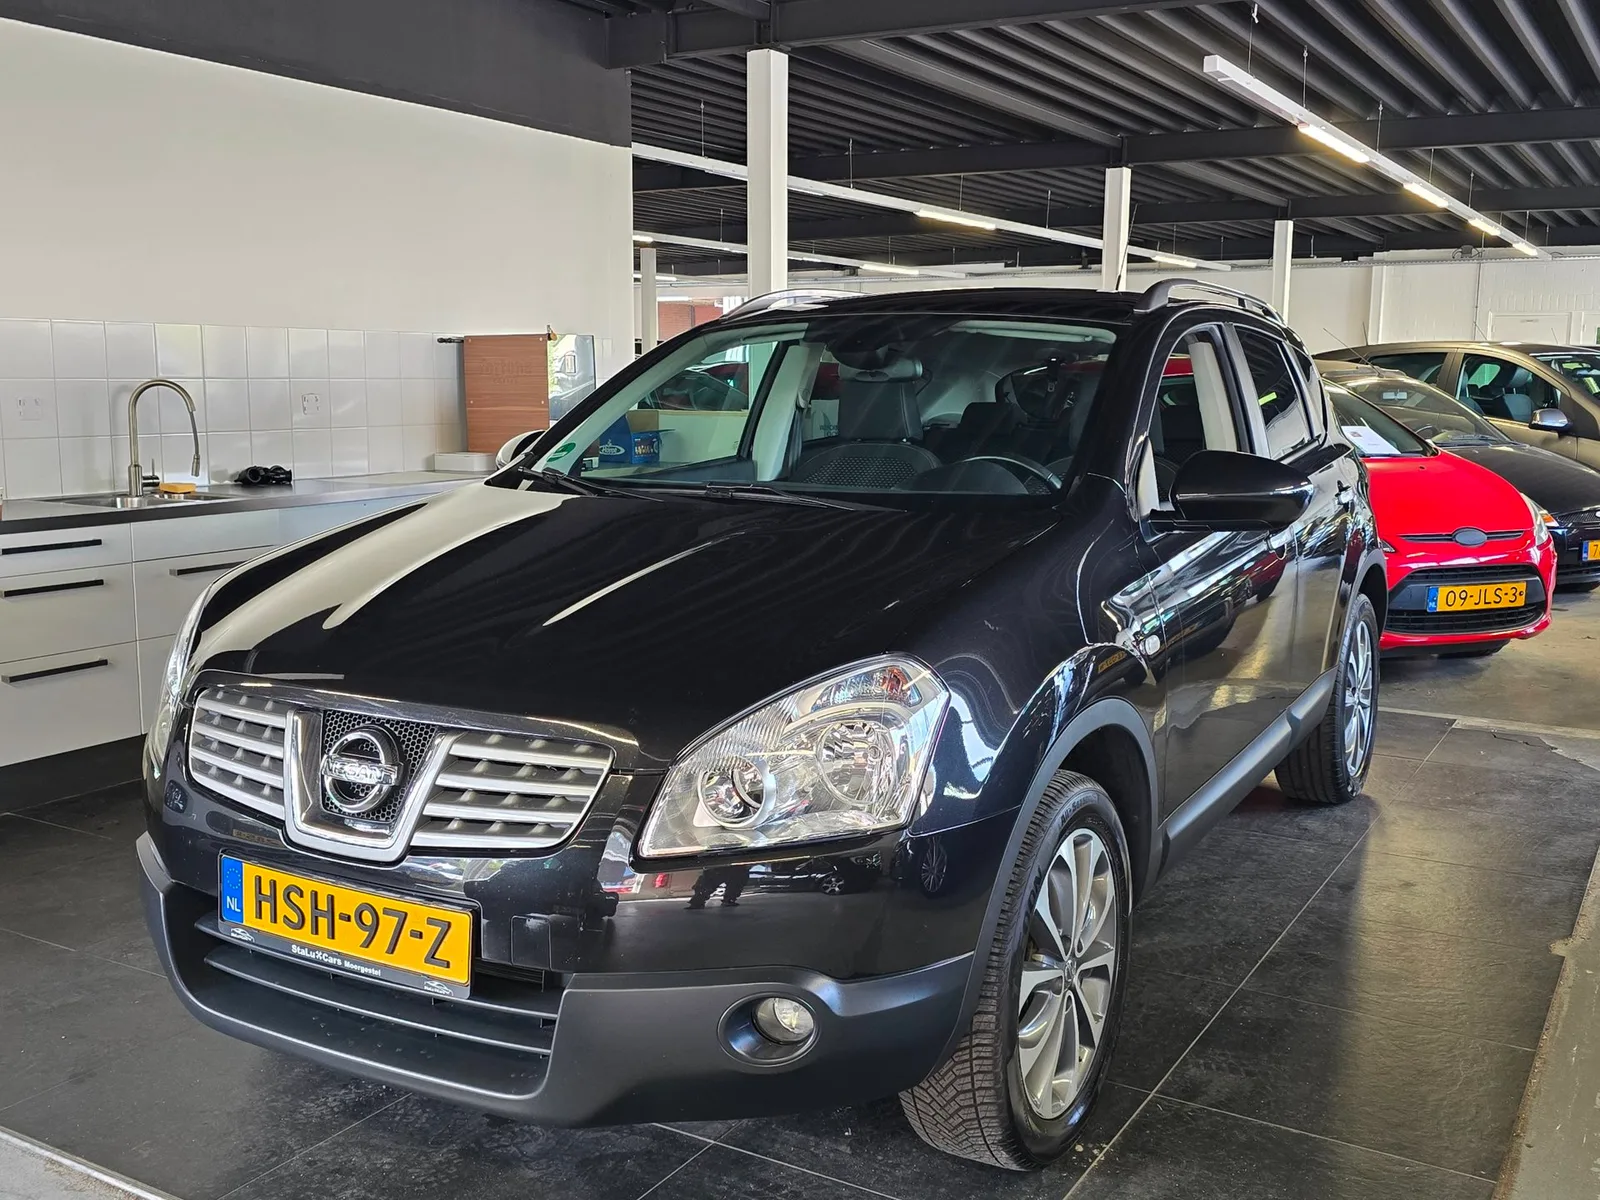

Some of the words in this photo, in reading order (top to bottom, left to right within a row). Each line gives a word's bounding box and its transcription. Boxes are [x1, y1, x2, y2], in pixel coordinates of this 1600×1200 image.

[1446, 586, 1518, 607] 09-JLS-3
[226, 896, 241, 912] NL
[254, 874, 451, 969] HSH-97-Z
